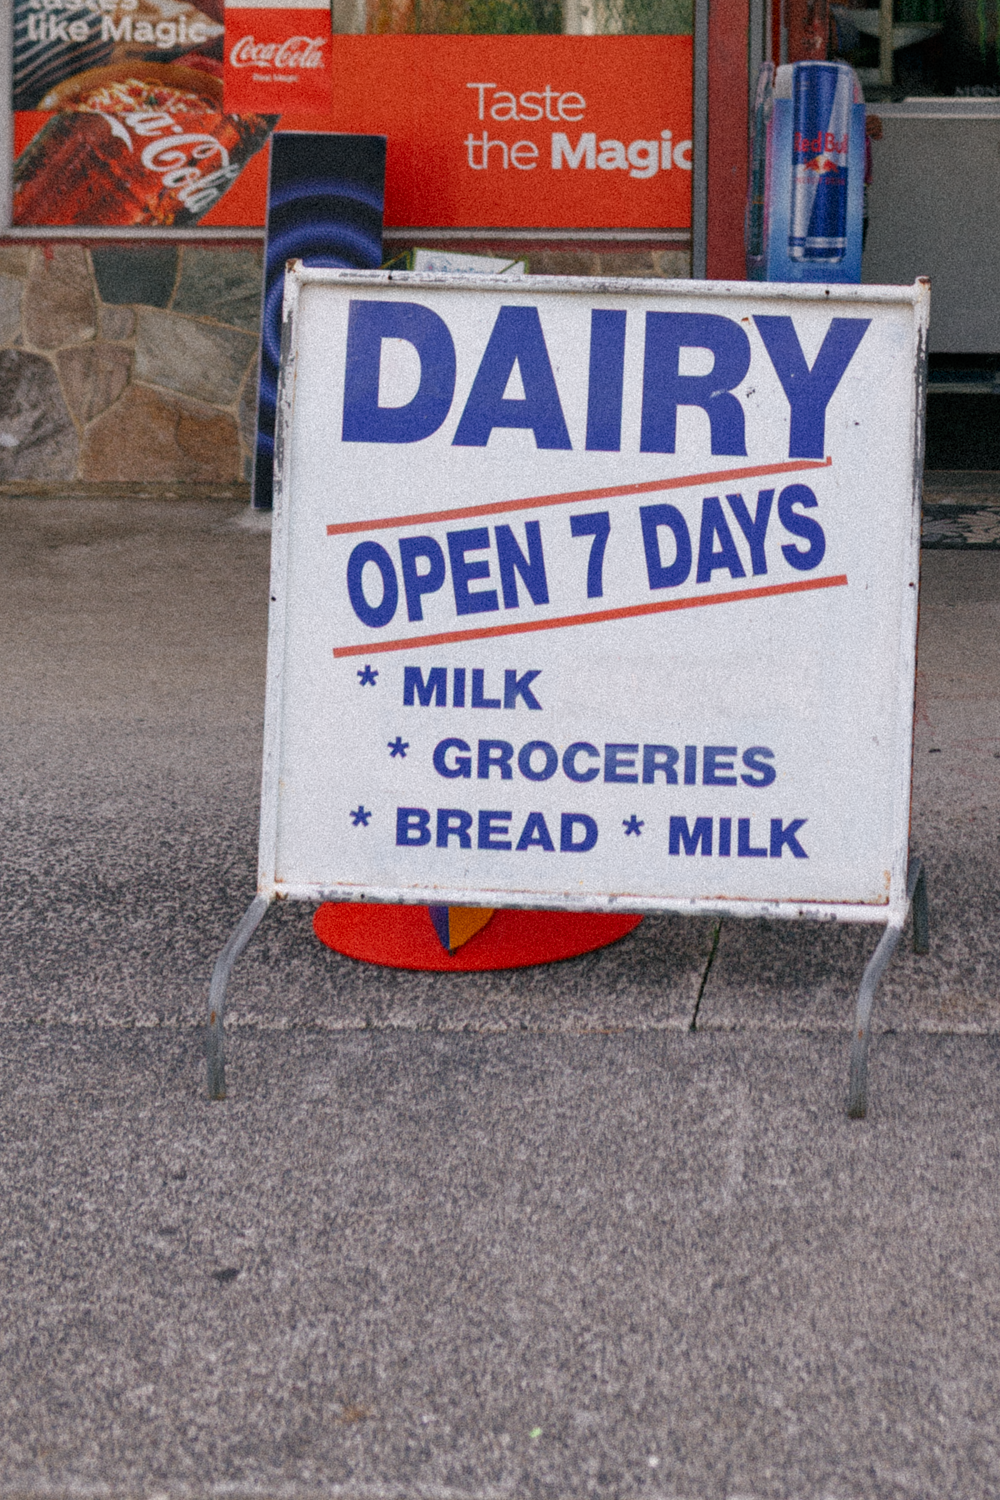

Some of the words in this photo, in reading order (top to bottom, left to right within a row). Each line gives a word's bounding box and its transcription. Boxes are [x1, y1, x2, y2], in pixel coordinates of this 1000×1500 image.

[27, 13, 90, 42] like
[101, 14, 208, 49] Magic
[230, 35, 328, 69] Coca-Cola
[466, 82, 586, 122] Taste
[464, 131, 539, 171] the
[793, 131, 822, 153] Red
[340, 298, 872, 460] DAIRY
[346, 518, 549, 628] OPEN
[571, 512, 611, 599] 7
[640, 483, 827, 591] DAYS
[402, 666, 542, 711] MILK
[432, 736, 777, 787] GROCERIES
[395, 807, 599, 853] BREAD
[667, 815, 809, 859] MILK
